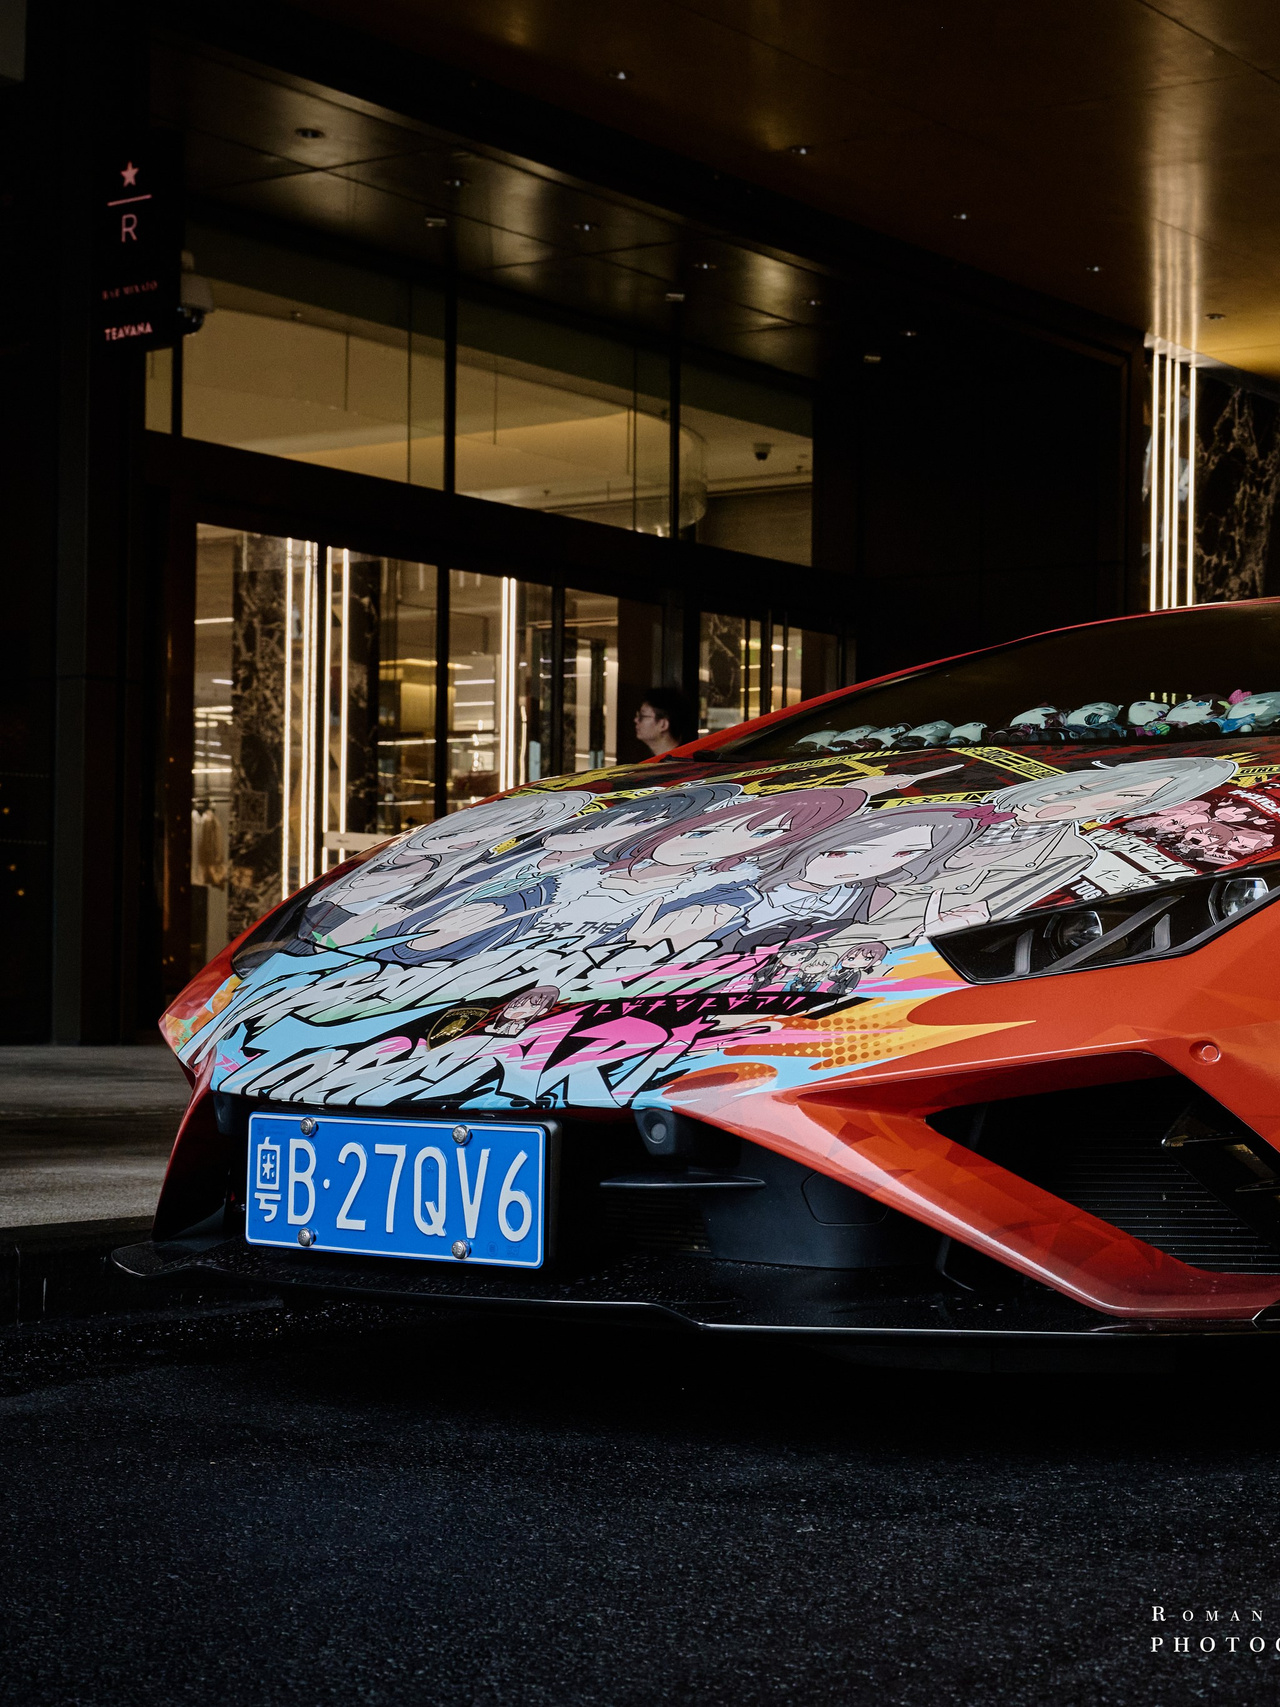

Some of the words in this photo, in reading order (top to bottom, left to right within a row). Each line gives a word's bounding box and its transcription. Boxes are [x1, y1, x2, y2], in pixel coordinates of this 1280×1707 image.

[121, 214, 138, 243] R
[105, 322, 153, 341] TEAVANA
[1070, 880, 1105, 901] TOG
